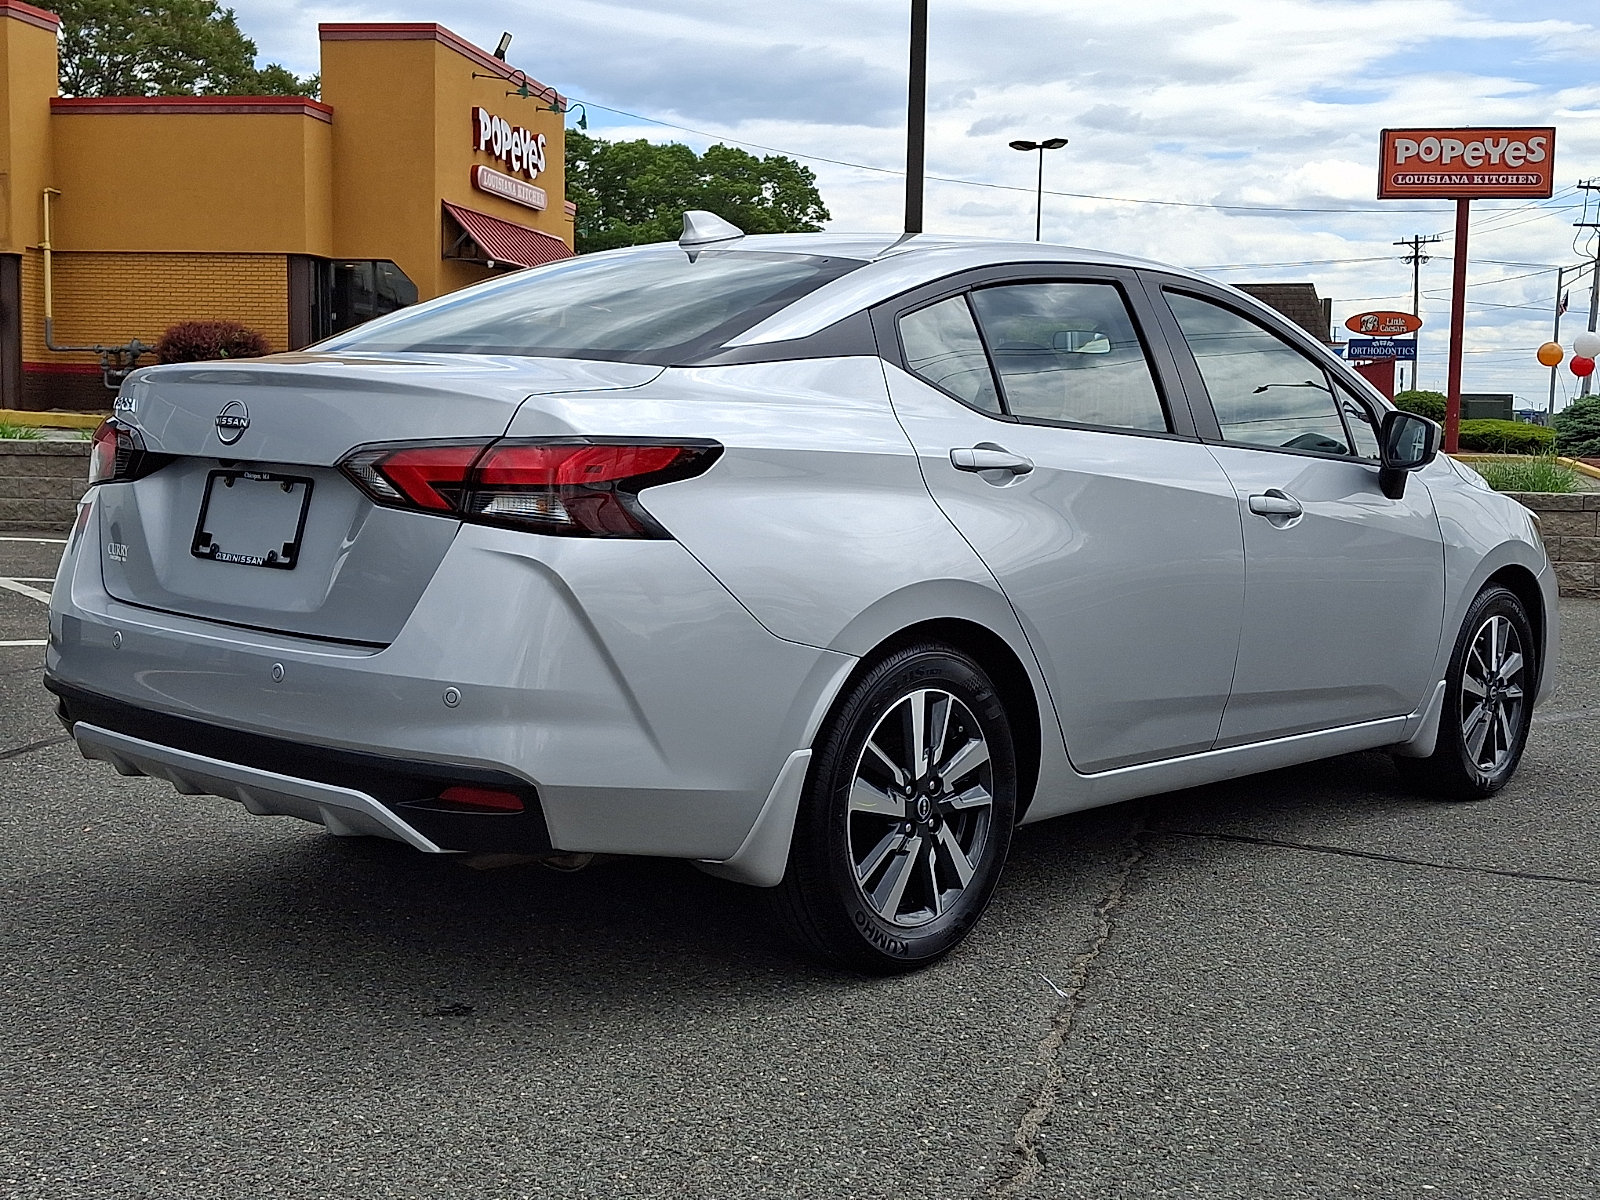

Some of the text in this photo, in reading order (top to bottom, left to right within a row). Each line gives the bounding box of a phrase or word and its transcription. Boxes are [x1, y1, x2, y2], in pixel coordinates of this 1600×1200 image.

[1397, 175, 1538, 184] LOUISIANA KITCHEN
[483, 171, 545, 207] LOUISIANA KITCHEN
[1380, 324, 1407, 332] Caesars
[1351, 347, 1415, 355] ORTHODONTICS
[107, 542, 129, 557] CURRY
[232, 554, 263, 565] NISSAN
[855, 911, 909, 955] KUMHO
